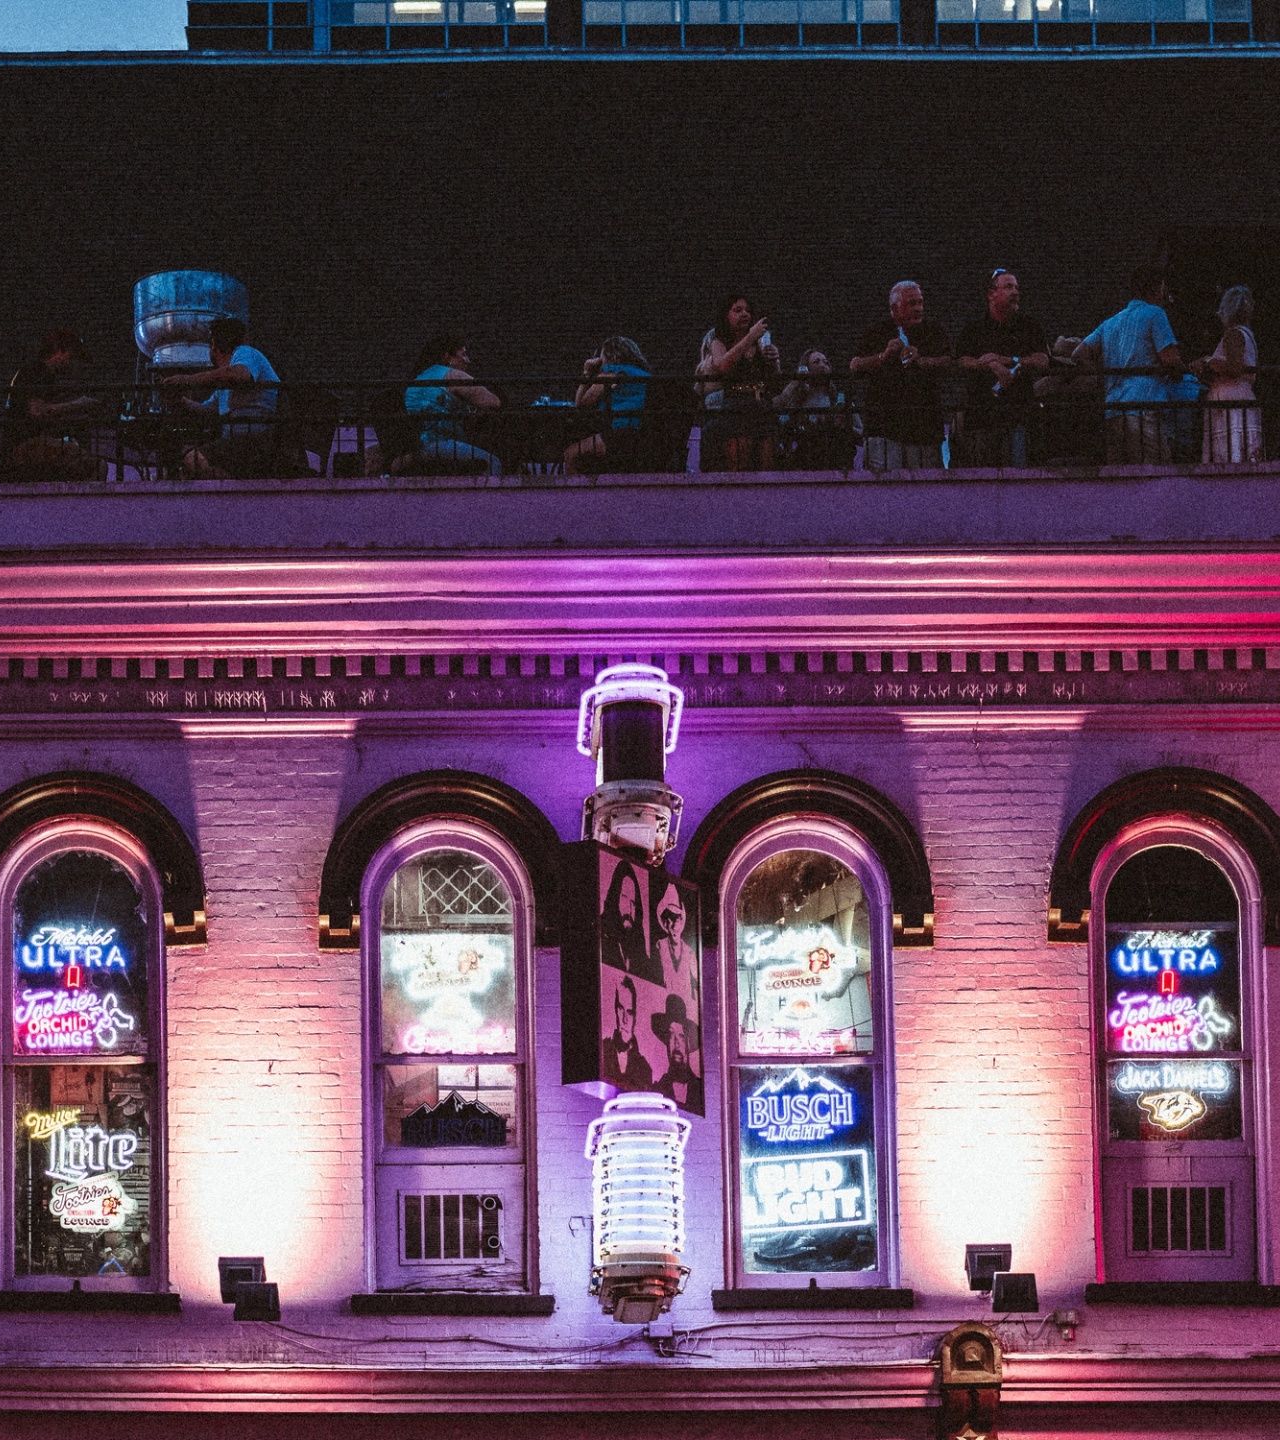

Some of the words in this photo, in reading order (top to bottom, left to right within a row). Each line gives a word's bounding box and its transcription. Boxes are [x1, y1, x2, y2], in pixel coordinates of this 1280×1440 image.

[22, 944, 126, 968] ULTRA
[1117, 949, 1218, 973] ULTRA
[15, 989, 102, 1024] Tootsies
[1110, 991, 1196, 1028] Tootsies
[27, 1016, 90, 1034] ORCHID
[1123, 1021, 1186, 1041] ORCHID
[25, 1032, 94, 1049] LOUNGE
[1121, 1035, 1189, 1052] LOUNGE
[1118, 1064, 1161, 1089] JACK
[25, 1108, 81, 1137] Miller
[746, 1092, 854, 1129] BUSCH
[45, 1126, 138, 1182] Lite
[755, 1160, 844, 1195] BUD
